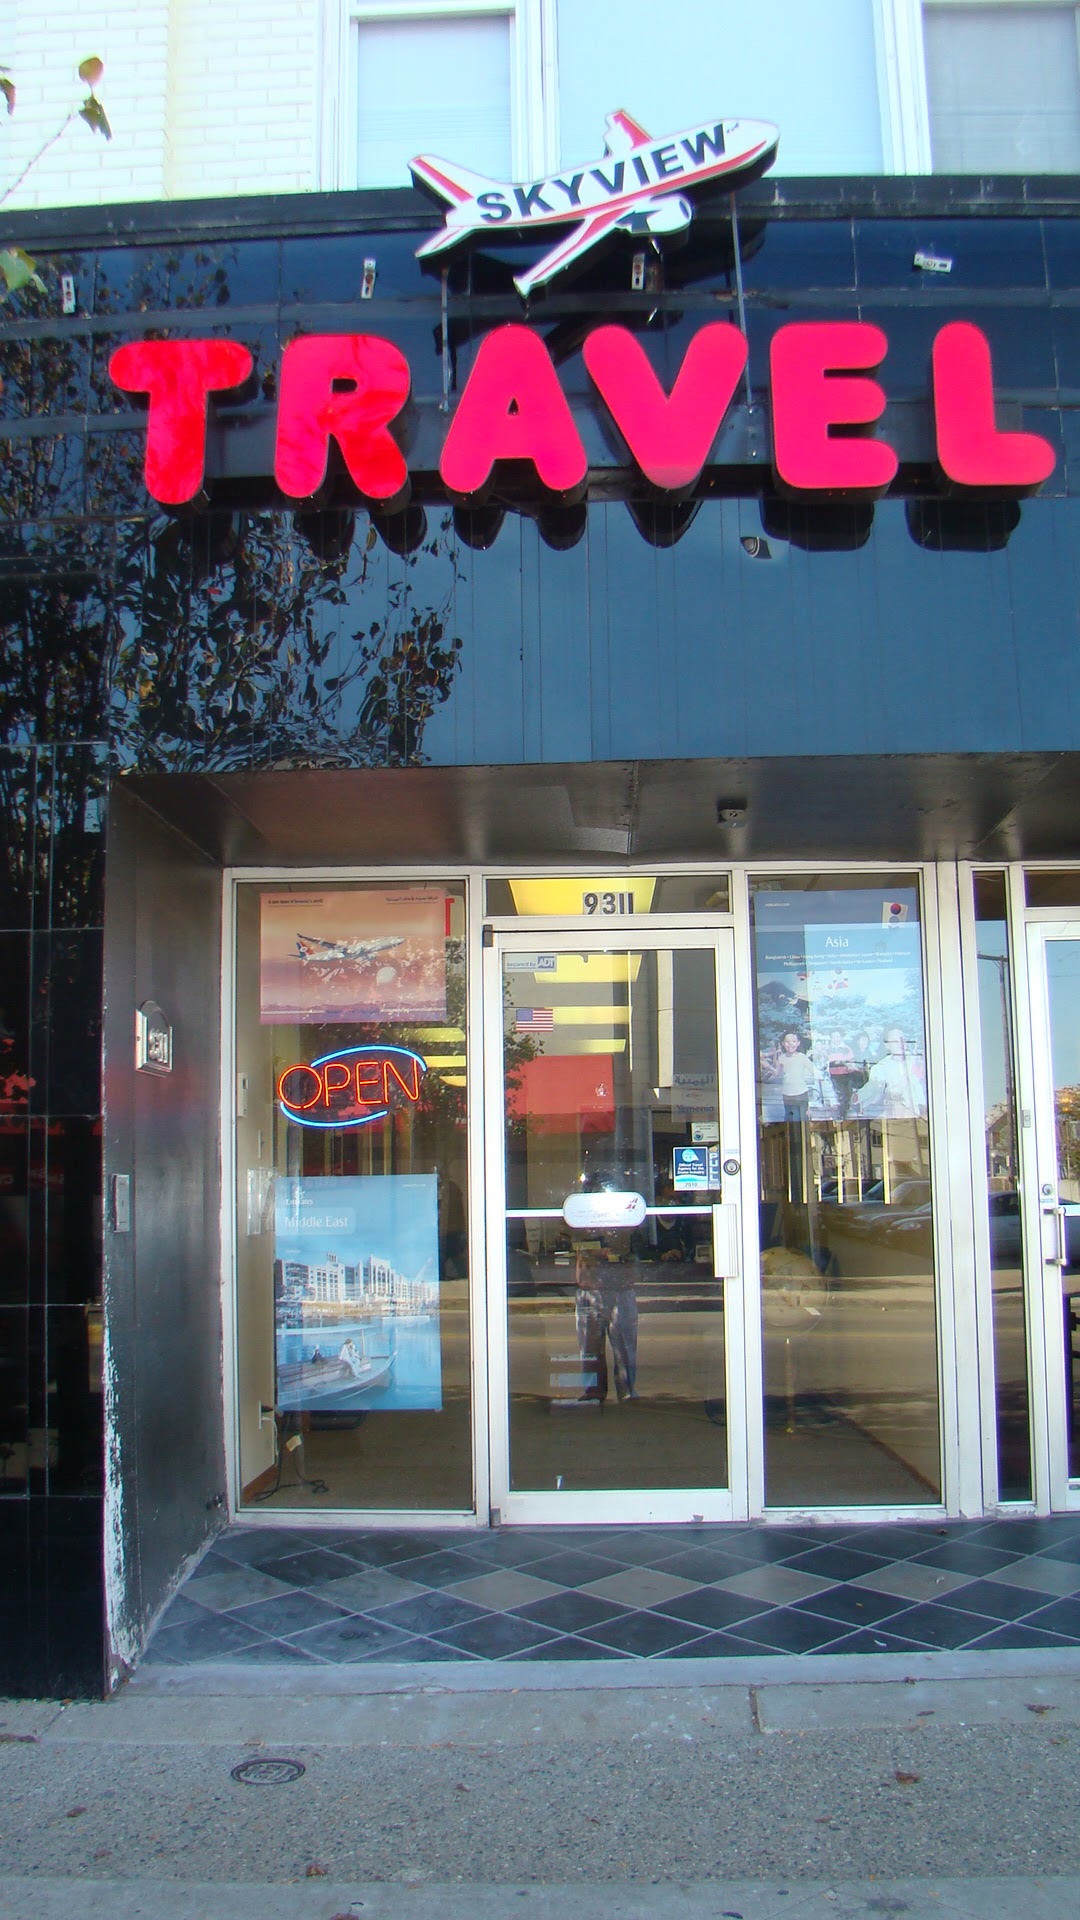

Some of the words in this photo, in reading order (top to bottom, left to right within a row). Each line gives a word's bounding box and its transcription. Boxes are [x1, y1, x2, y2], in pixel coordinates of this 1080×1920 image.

[475, 123, 727, 224] SKYVIEW
[108, 322, 1057, 506] TRAVEL
[584, 892, 633, 915] 9311
[825, 936, 849, 948] Asia
[538, 956, 555, 968] ADT
[278, 1060, 421, 1109] OPEN
[709, 1153, 719, 1180] PULL
[285, 1216, 322, 1227] Middle
[325, 1216, 348, 1227] East
